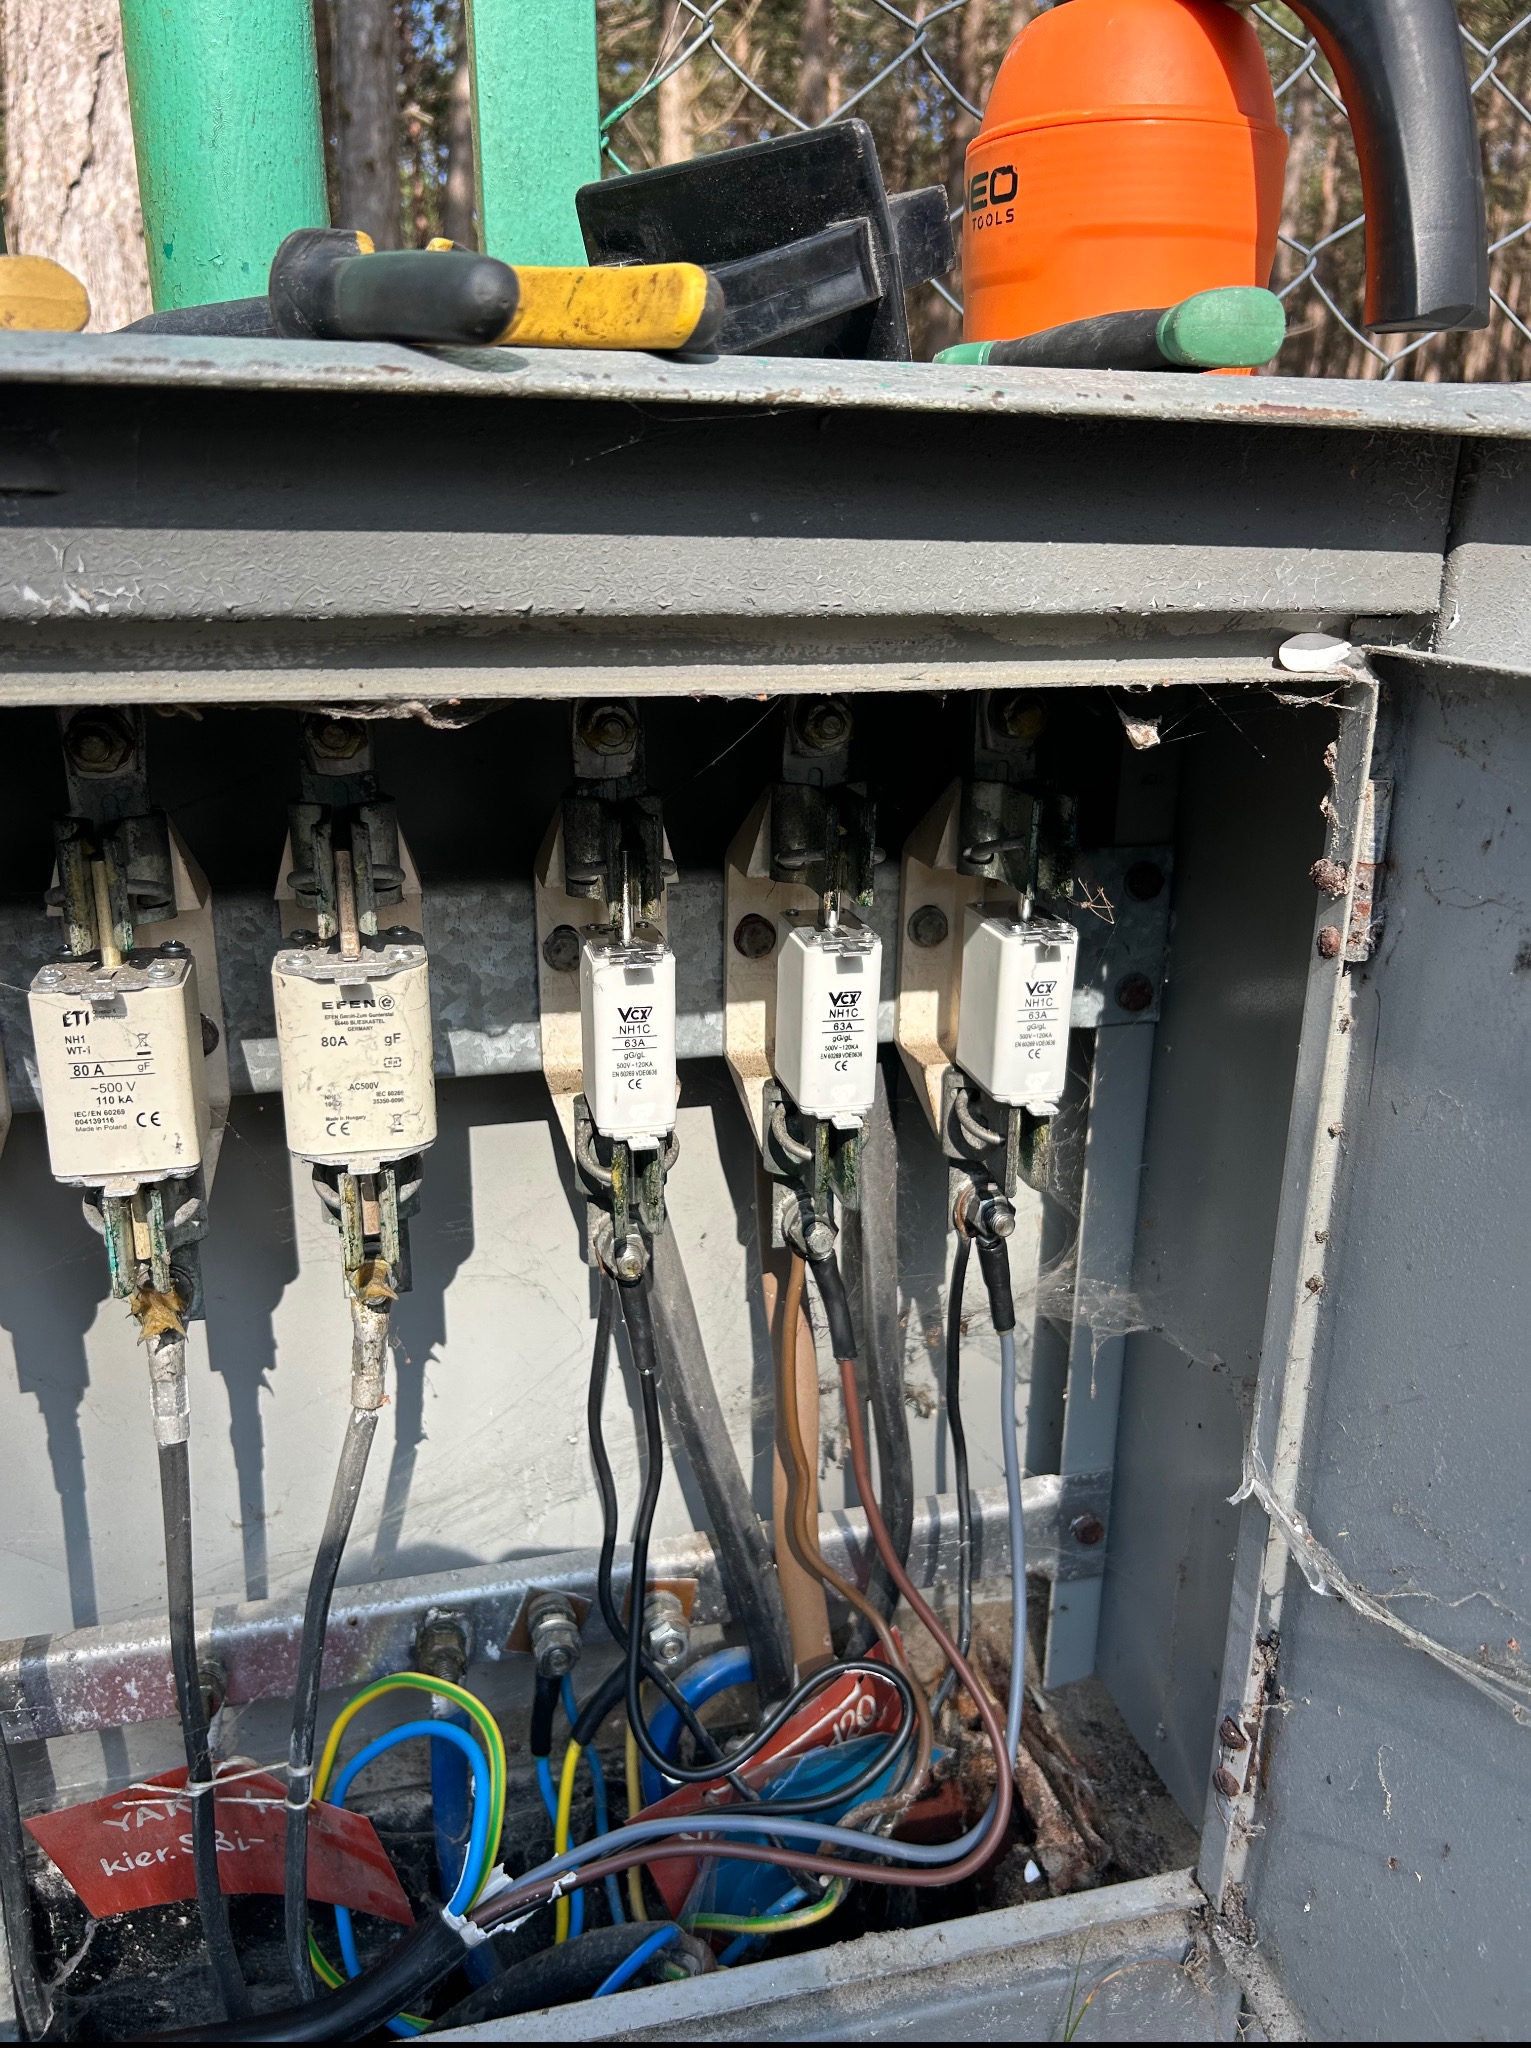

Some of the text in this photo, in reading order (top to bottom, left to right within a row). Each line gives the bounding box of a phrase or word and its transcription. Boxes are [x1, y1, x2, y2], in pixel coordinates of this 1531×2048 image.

[967, 165, 1018, 214] EO
[972, 208, 1015, 232] TOOLS
[321, 999, 376, 1011] EFEN
[1024, 997, 1054, 1008] NH1C
[828, 1007, 859, 1018] NH1C
[1028, 1011, 1048, 1020] 63A
[62, 1010, 91, 1028] ETI
[619, 1024, 651, 1035] NH1C
[833, 1022, 853, 1031] 63A
[64, 1034, 86, 1045] NH1
[320, 1033, 402, 1047] 80A gF
[624, 1039, 646, 1048] 63A
[1028, 1048, 1042, 1060] CE
[73, 1062, 151, 1077] 80 A gF
[834, 1060, 848, 1072] CE
[90, 1081, 137, 1094] ~500 V
[349, 1081, 380, 1091] AC500V
[628, 1078, 643, 1090] CE
[96, 1095, 134, 1105] 110 kA
[73, 1108, 126, 1118] IEC/EN 60269
[136, 1111, 162, 1128] CE
[75, 1125, 95, 1133] Made
[103, 1123, 128, 1131] Poland
[326, 1121, 351, 1137] CE
[99, 1846, 177, 1877] kier.
